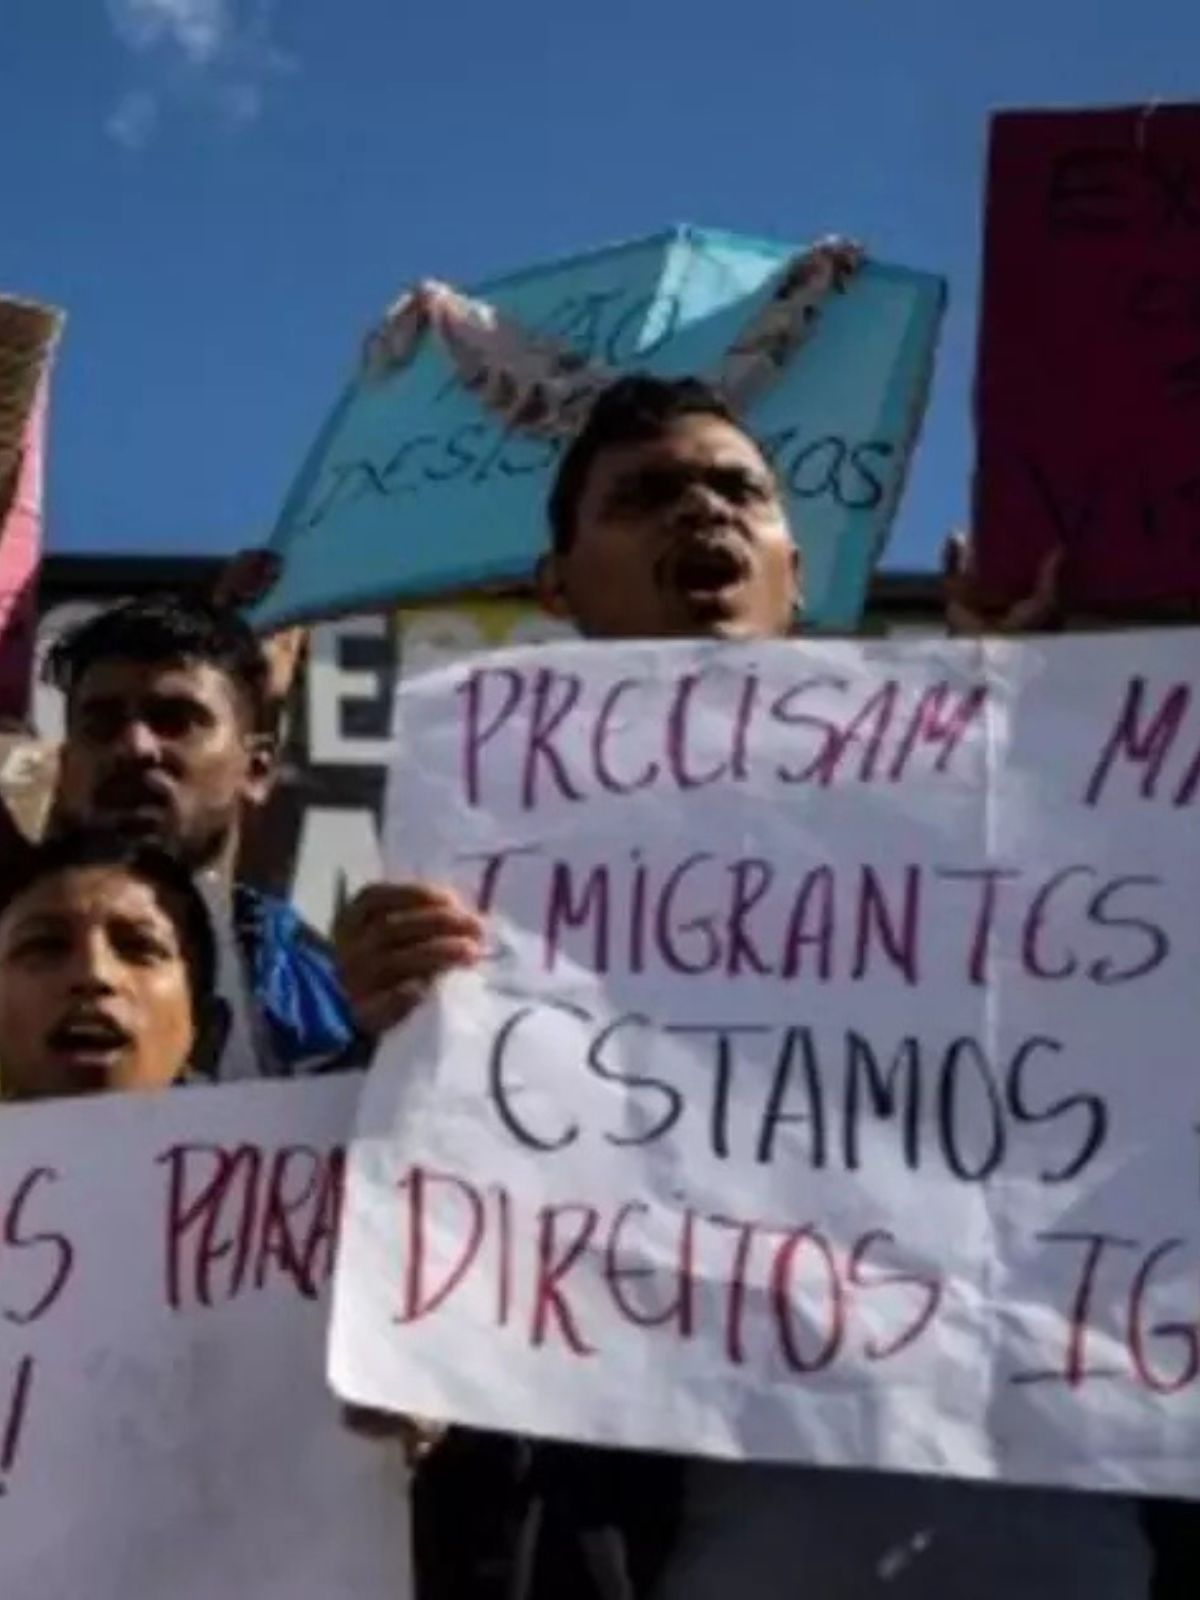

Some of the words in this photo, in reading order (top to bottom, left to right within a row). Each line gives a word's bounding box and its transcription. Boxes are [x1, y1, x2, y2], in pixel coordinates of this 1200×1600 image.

[456, 662, 988, 808] PRECISAM
[1084, 674, 1200, 808] M
[455, 843, 1170, 987] IMIGRANTES
[490, 1000, 1108, 1184] ESTAMOS
[154, 1142, 346, 1310] PARA
[394, 1164, 942, 1373] DIREITOS
